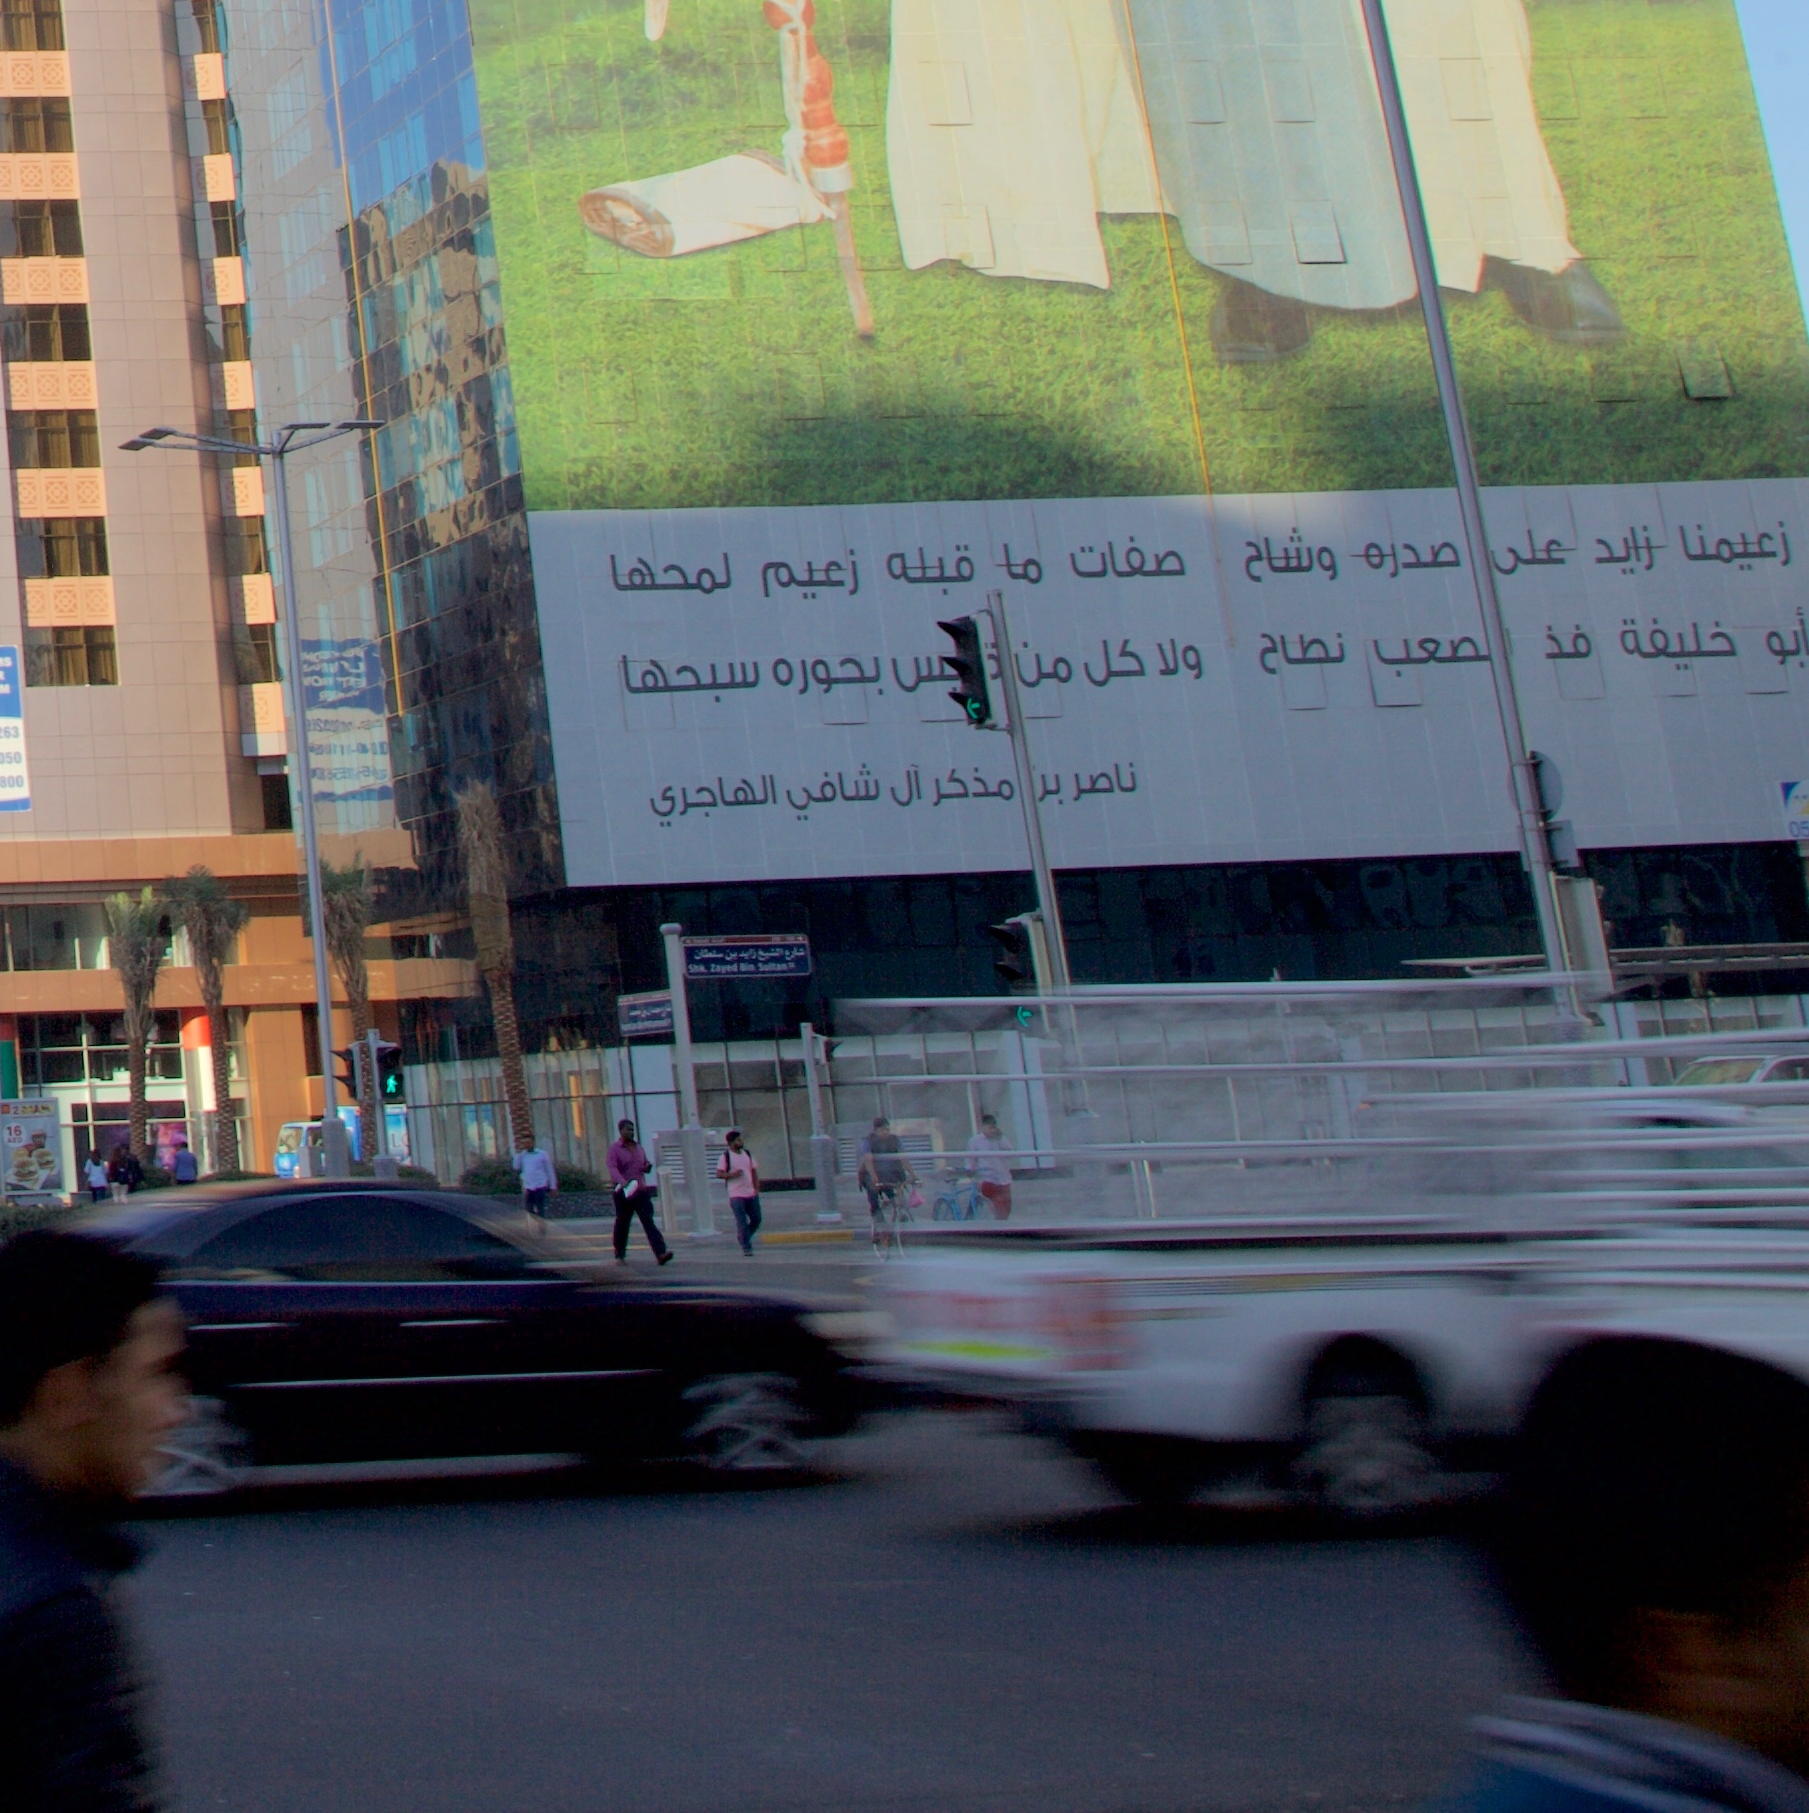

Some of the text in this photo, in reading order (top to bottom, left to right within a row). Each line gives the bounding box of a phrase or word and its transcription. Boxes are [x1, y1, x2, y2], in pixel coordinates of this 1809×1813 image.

[609, 521, 1790, 599] زعيمنا زايد على صدره وشاح صفات ما قبله زعيم لمحها
[1257, 632, 1345, 675] نطاح
[1544, 623, 1592, 660] فذ
[1619, 617, 1737, 671] خليفة
[1765, 606, 1809, 668] أبو
[621, 654, 759, 703] سبحها
[771, 655, 884, 697] بحوره
[1013, 640, 1073, 689] من
[1082, 638, 1147, 688] كل
[650, 774, 778, 827] الهاجري
[785, 763, 881, 821] شافي
[889, 764, 922, 808] آل
[932, 767, 1015, 807] مذكر
[1073, 762, 1138, 803] ناصر
[709, 962, 738, 974] Zayed
[739, 961, 757, 972] Bin
[757, 961, 788, 972] Sultan
[757, 947, 784, 961] الشيخ
[784, 947, 805, 961] شارع
[6, 1126, 22, 1137] 16
